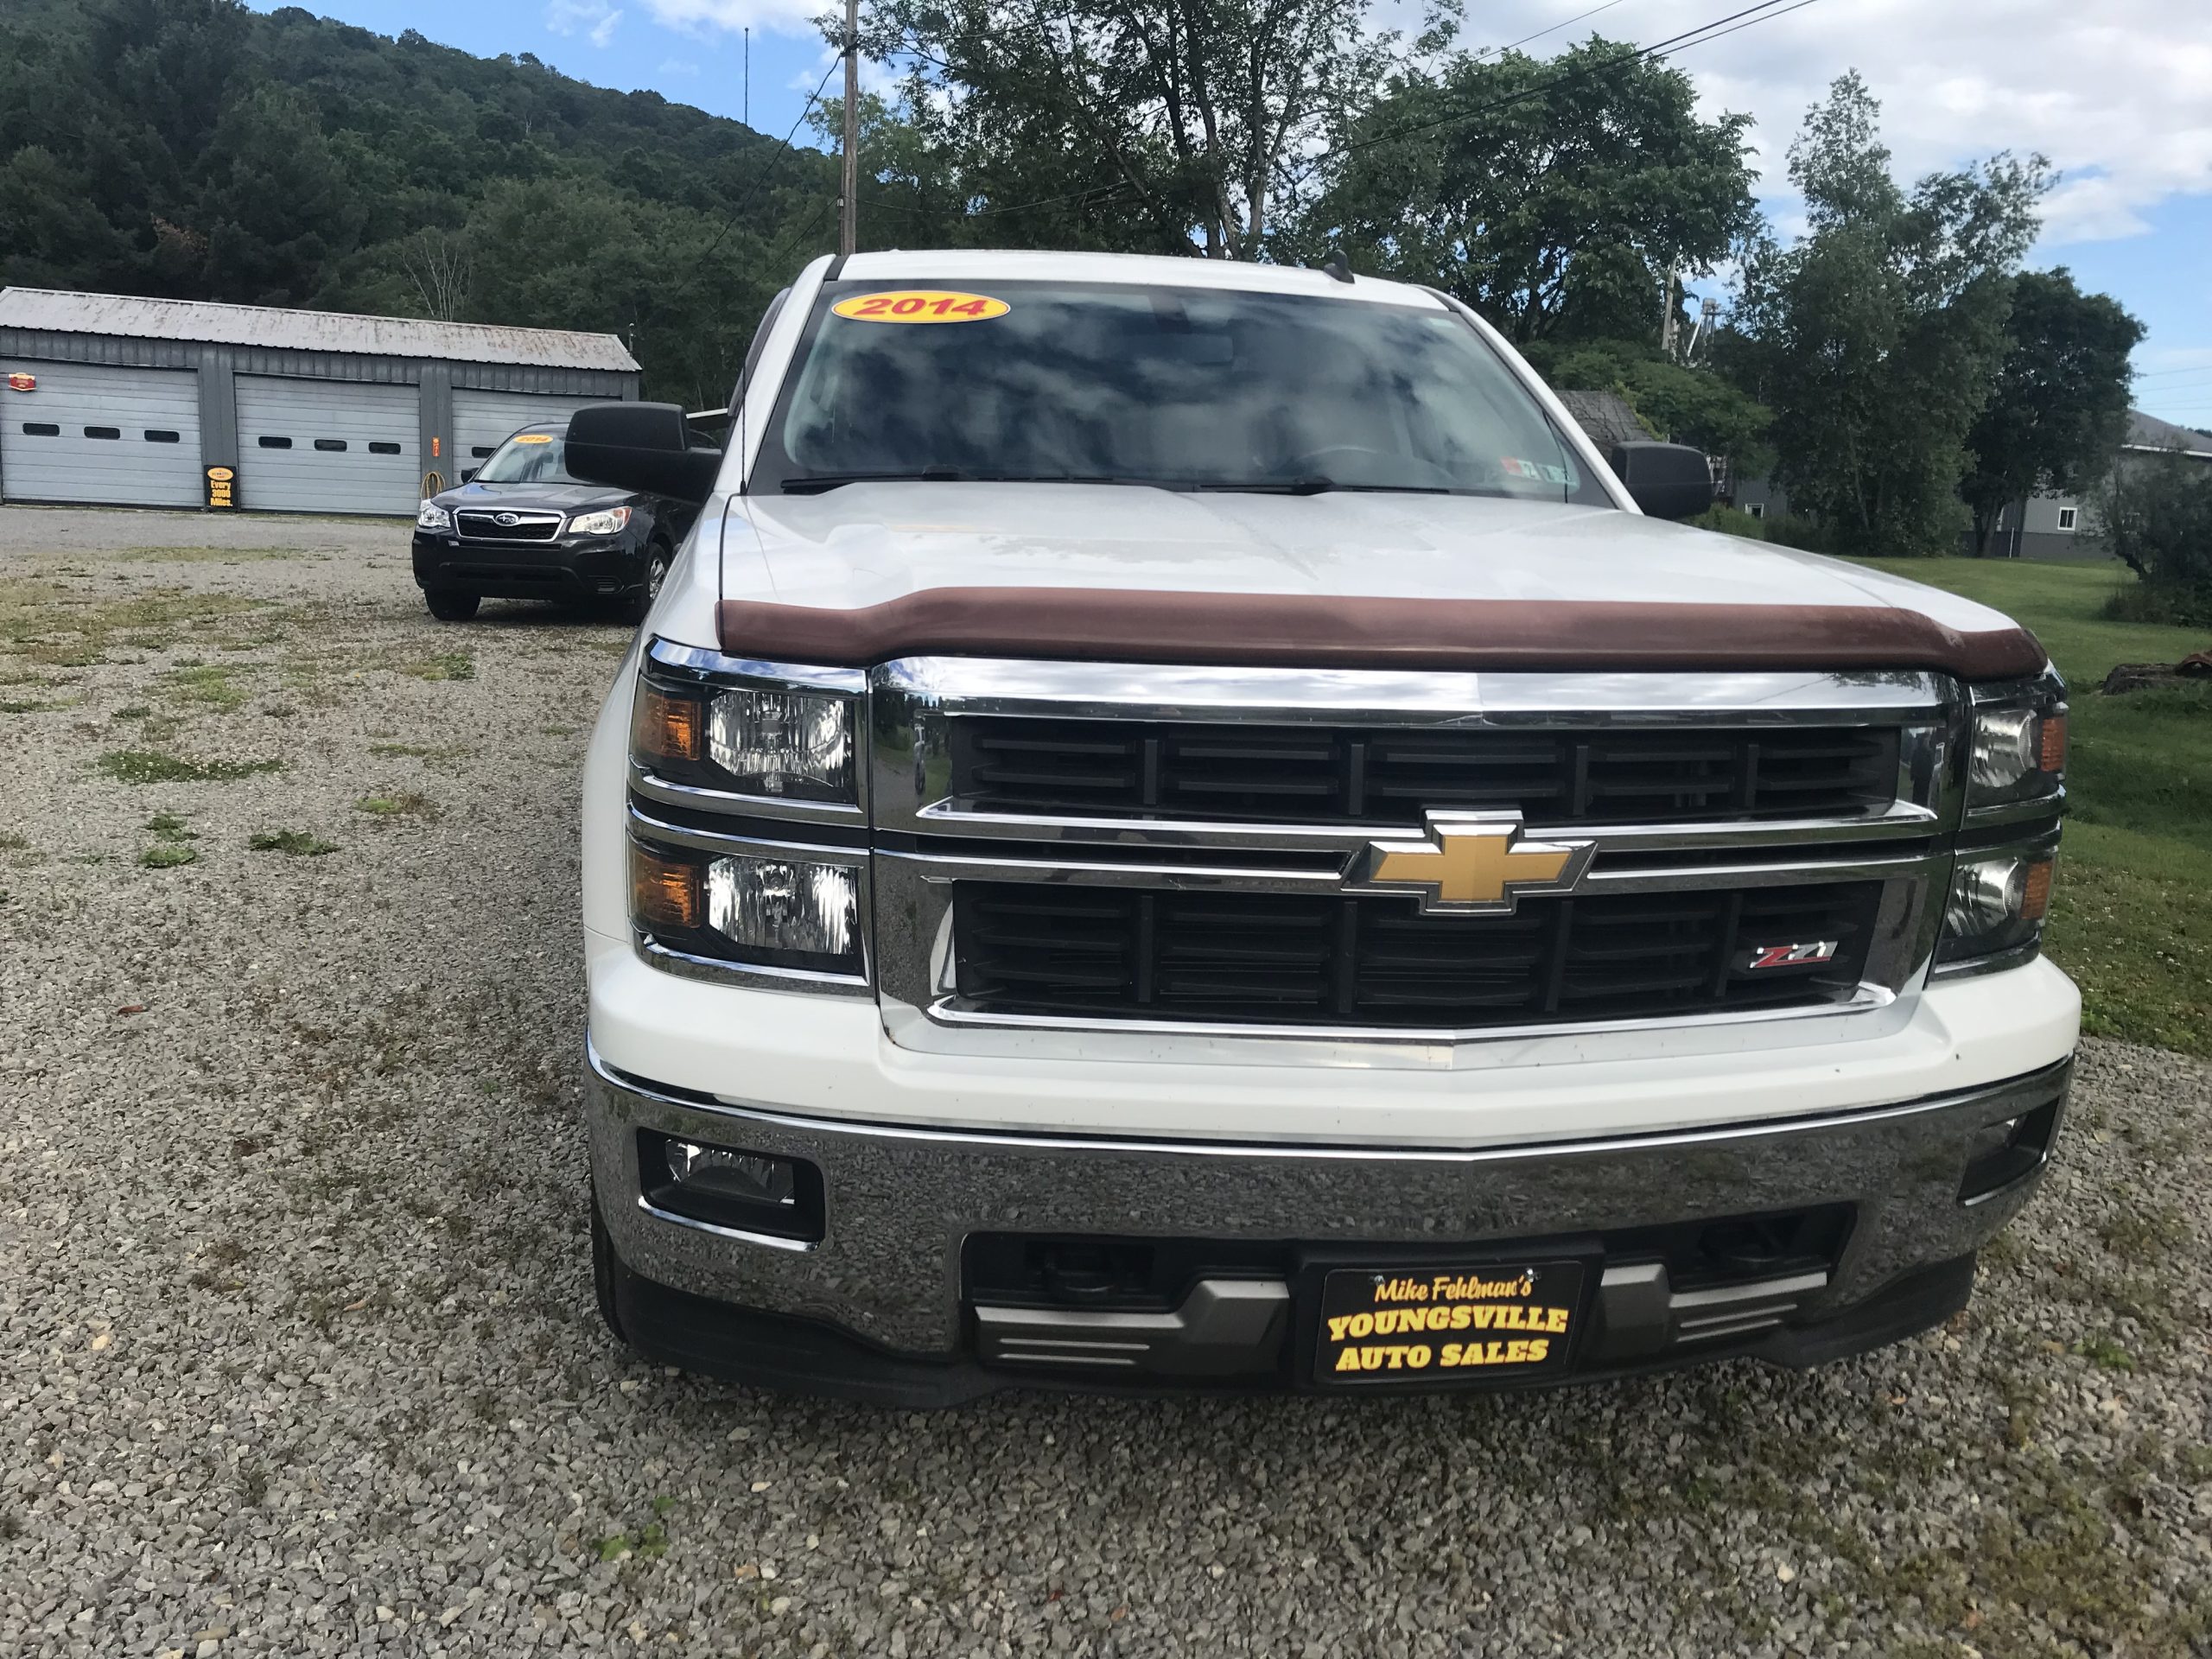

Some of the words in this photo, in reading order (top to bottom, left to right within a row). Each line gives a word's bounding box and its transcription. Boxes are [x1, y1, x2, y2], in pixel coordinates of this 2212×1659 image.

[853, 298, 988, 315] 2014
[211, 480, 231, 490] Every
[212, 489, 231, 498] 3000
[1750, 941, 1838, 968] Z71
[1374, 1279, 1428, 1302] Mike
[1432, 1274, 1532, 1301] Fehlman's
[1327, 1305, 1569, 1342] YOUNGSVILLE
[1335, 1344, 1432, 1371] AUTO
[1440, 1339, 1550, 1367] SALES
